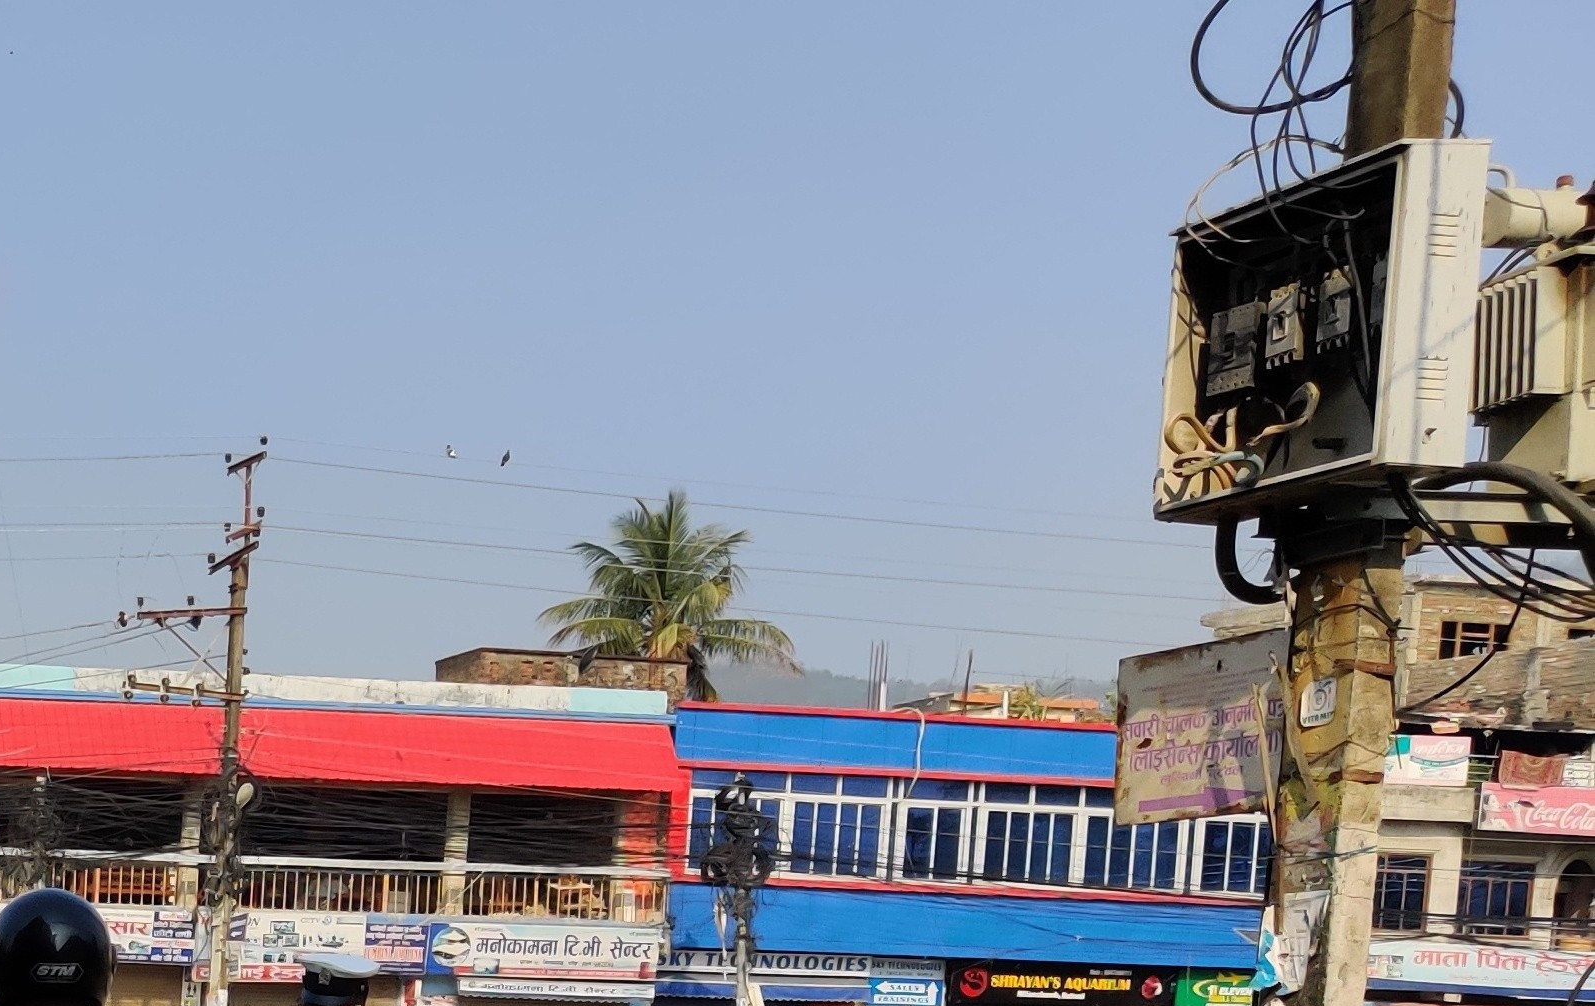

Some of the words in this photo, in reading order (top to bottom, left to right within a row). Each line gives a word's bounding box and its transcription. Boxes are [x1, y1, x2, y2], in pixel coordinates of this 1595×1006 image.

[476, 932, 558, 956] मनोकामना
[610, 935, 654, 960] सेन्टर
[657, 951, 700, 967] SKY
[1413, 950, 1469, 968] माता
[1476, 947, 1526, 971] पिता
[990, 974, 1061, 989] SHRAYAN'S
[1064, 976, 1132, 991] AQUARIUM
